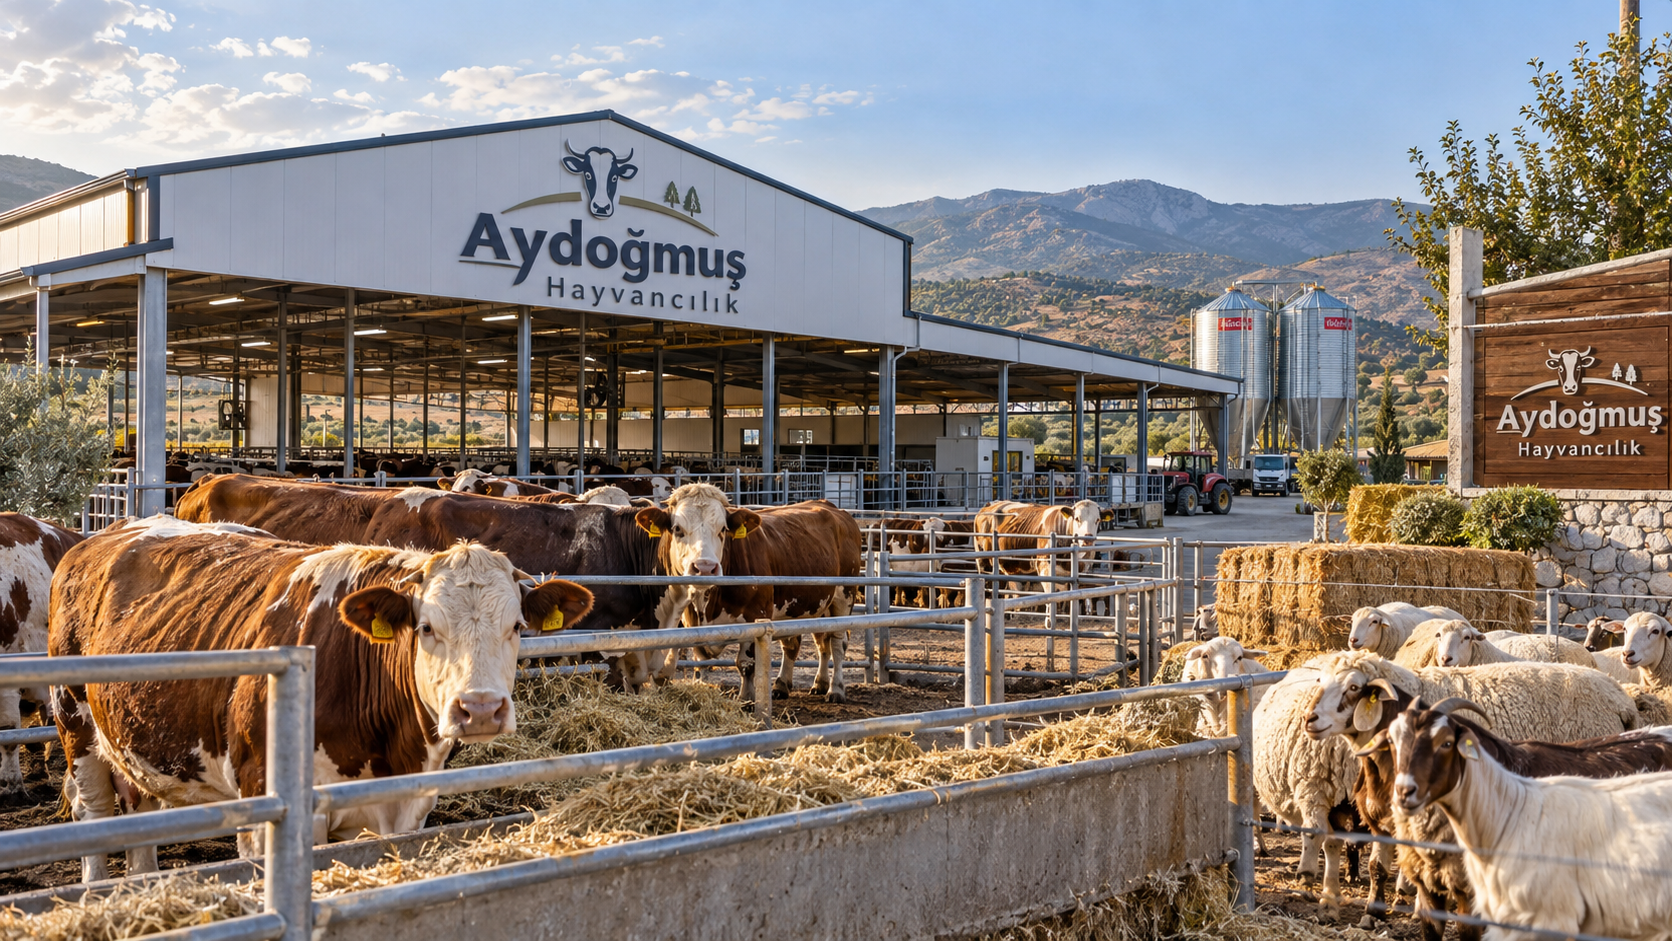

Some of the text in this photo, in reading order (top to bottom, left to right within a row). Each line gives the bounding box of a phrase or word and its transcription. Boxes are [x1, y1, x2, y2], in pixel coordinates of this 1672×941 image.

[459, 212, 747, 290] Aydoğmuş
[547, 276, 740, 314] Hayvancılık
[1496, 400, 1663, 438] Aydoğmuş
